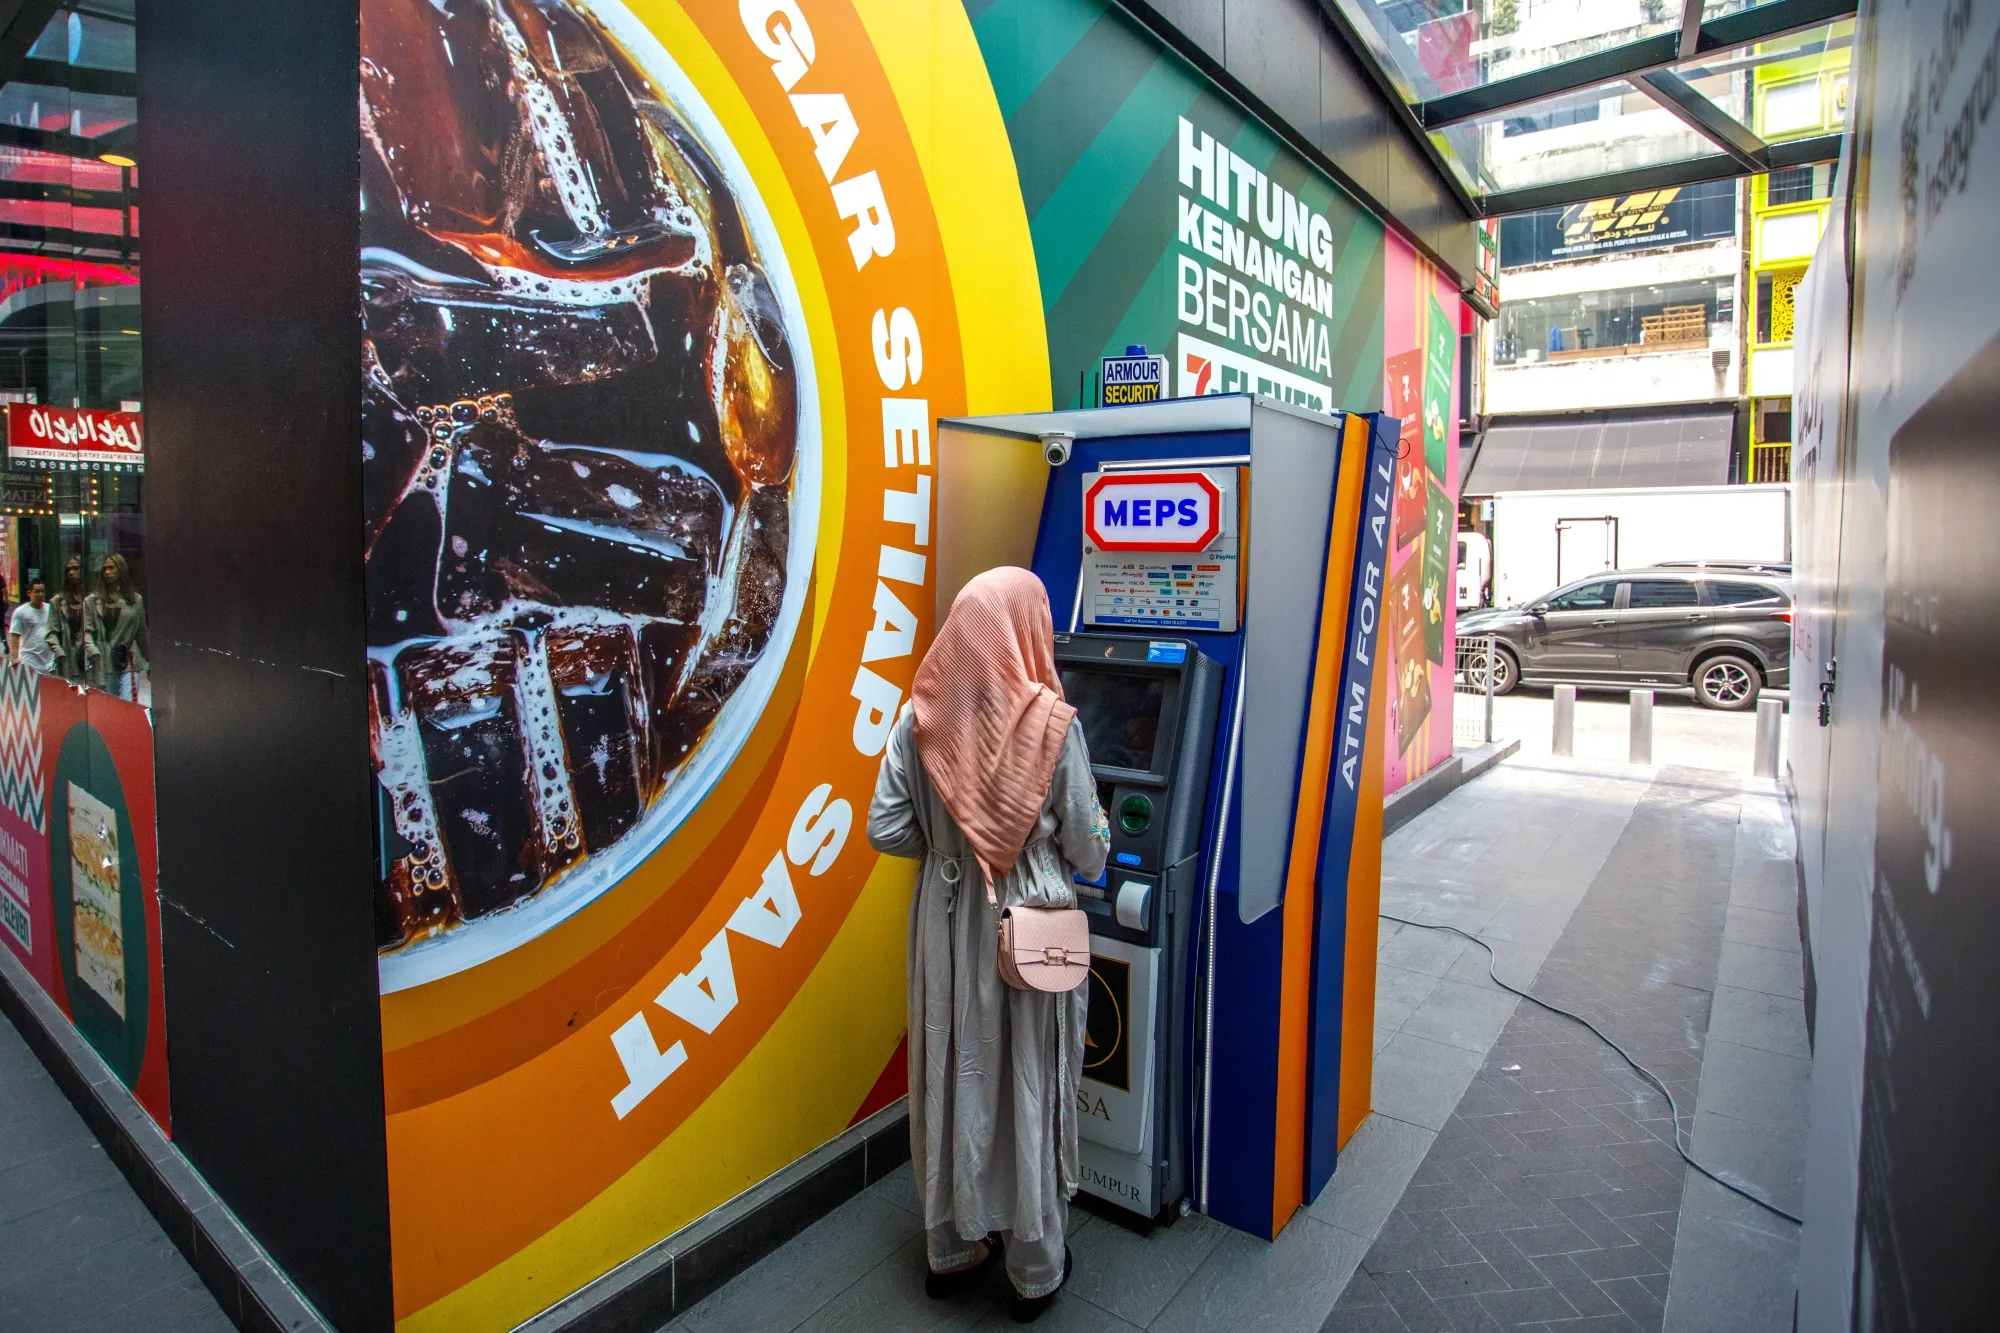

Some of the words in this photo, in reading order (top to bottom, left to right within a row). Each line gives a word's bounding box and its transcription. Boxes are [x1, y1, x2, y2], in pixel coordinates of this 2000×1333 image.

[1178, 114, 1333, 276] HITUNG
[1178, 194, 1333, 319] KENANGAN
[1105, 361, 1159, 382] ARMOUR
[1178, 253, 1333, 379] BERSAMA
[1105, 384, 1159, 404] SECURITY
[851, 306, 932, 757] SETIAP
[1104, 499, 1199, 527] MEPS
[1341, 683, 1366, 791] ATM
[1355, 561, 1380, 666] FOR
[1371, 457, 1393, 550] ALL
[610, 783, 853, 1121] SAAT
[1079, 1164, 1142, 1204] UMPUR
